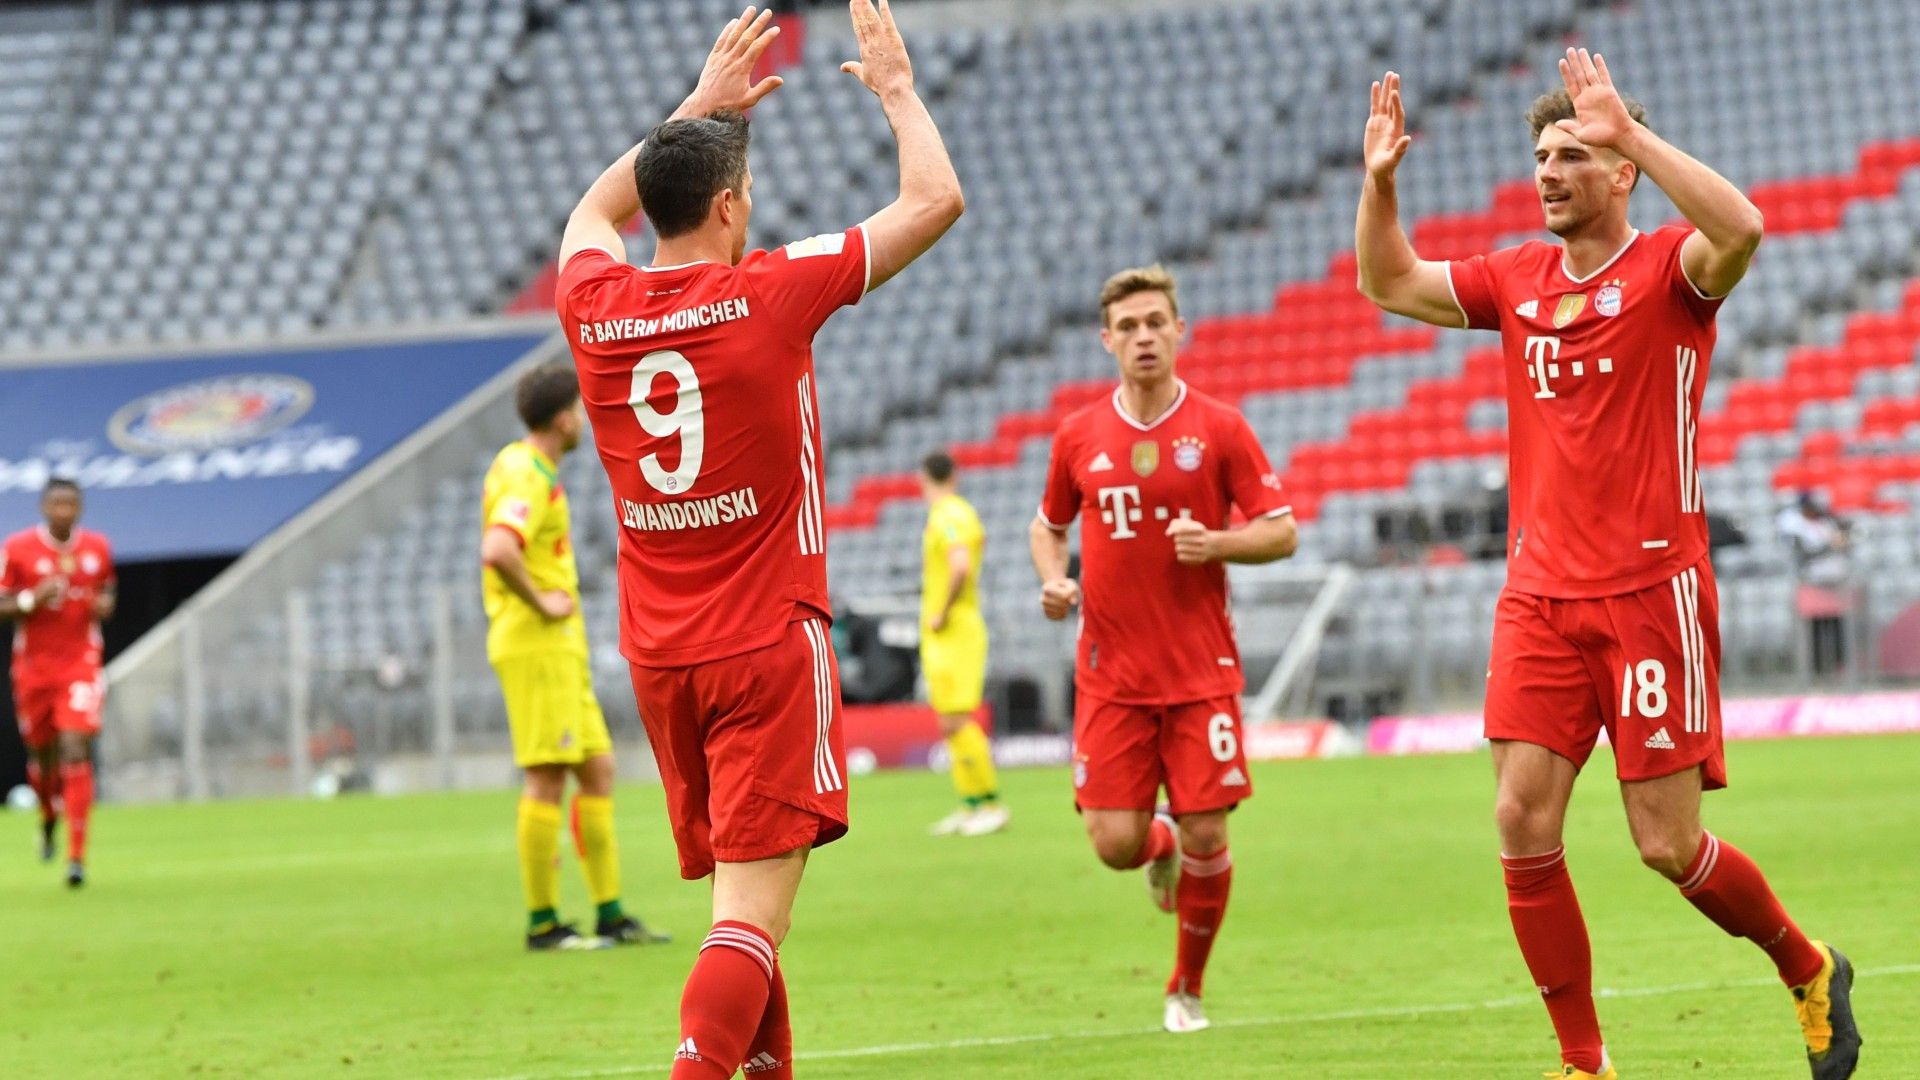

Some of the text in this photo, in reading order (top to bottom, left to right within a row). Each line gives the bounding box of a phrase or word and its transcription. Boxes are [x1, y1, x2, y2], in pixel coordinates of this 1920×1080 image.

[580, 297, 750, 344] FC BAYERN MÜNCHEN
[627, 350, 704, 495] 9
[0, 436, 360, 492] AULANER
[620, 487, 759, 531] LEWANDOWSKI
[1621, 658, 1669, 718] 18
[1208, 712, 1238, 762] 6
